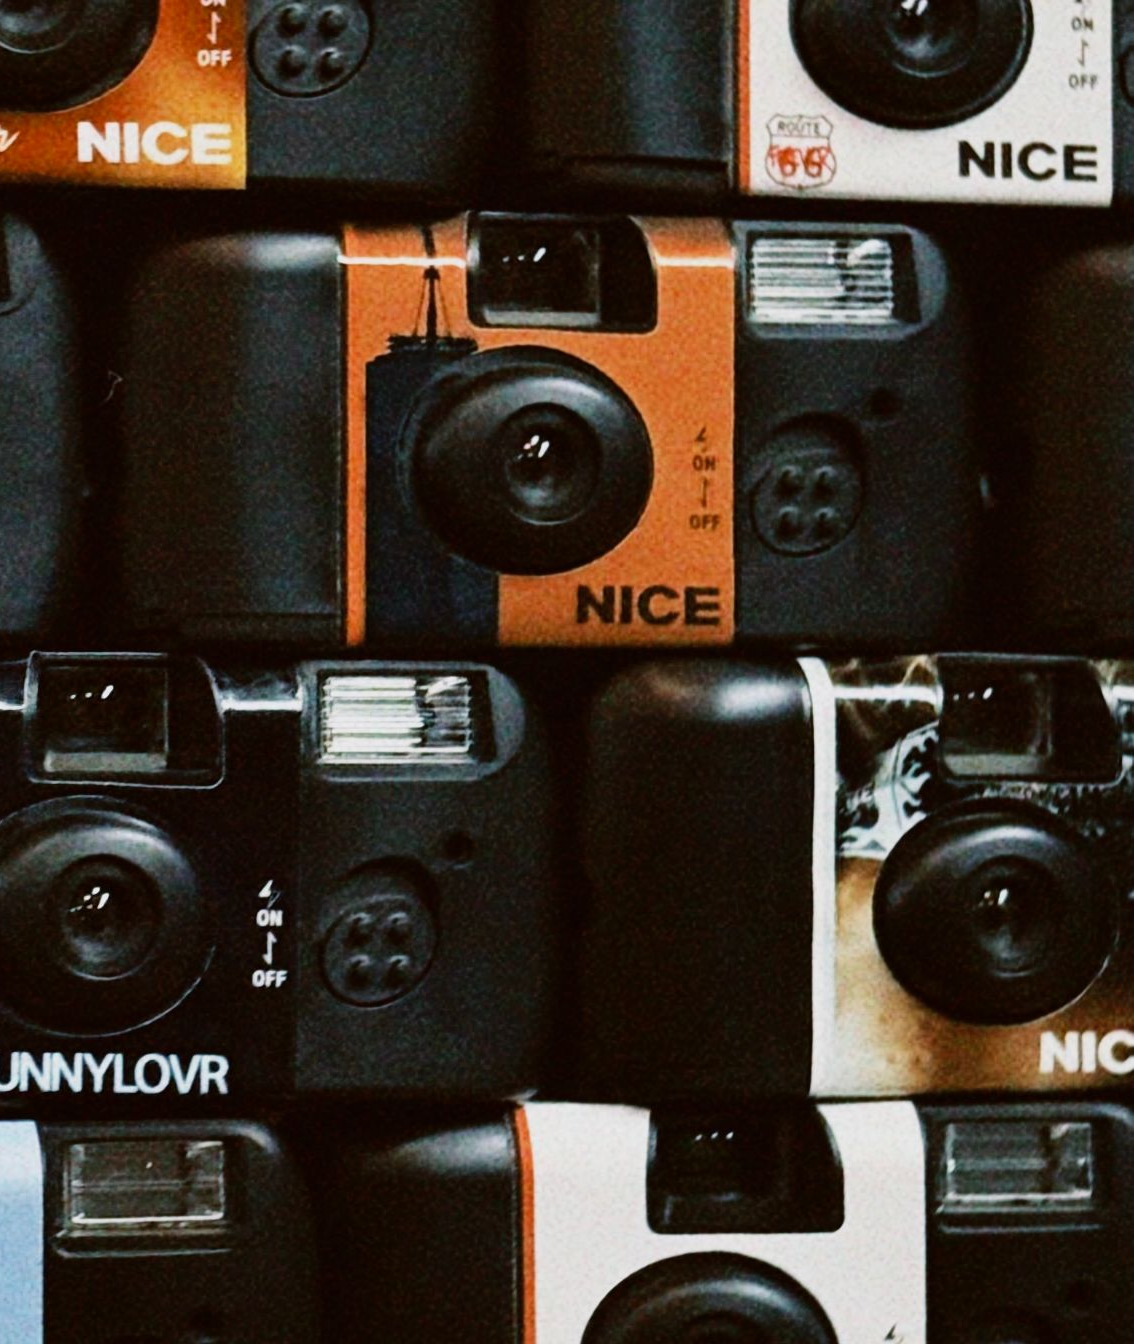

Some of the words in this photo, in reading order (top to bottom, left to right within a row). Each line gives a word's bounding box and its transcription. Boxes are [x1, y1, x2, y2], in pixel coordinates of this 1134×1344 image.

[1071, 16, 1094, 31] ON
[196, 49, 232, 67] OFF
[1068, 74, 1098, 89] OFF
[78, 121, 235, 165] NICE
[959, 141, 1097, 181] NICE
[692, 454, 716, 472] ON
[689, 514, 721, 531] OFF
[576, 585, 720, 626] NICE
[256, 909, 283, 927] ON
[252, 969, 288, 988] OFF
